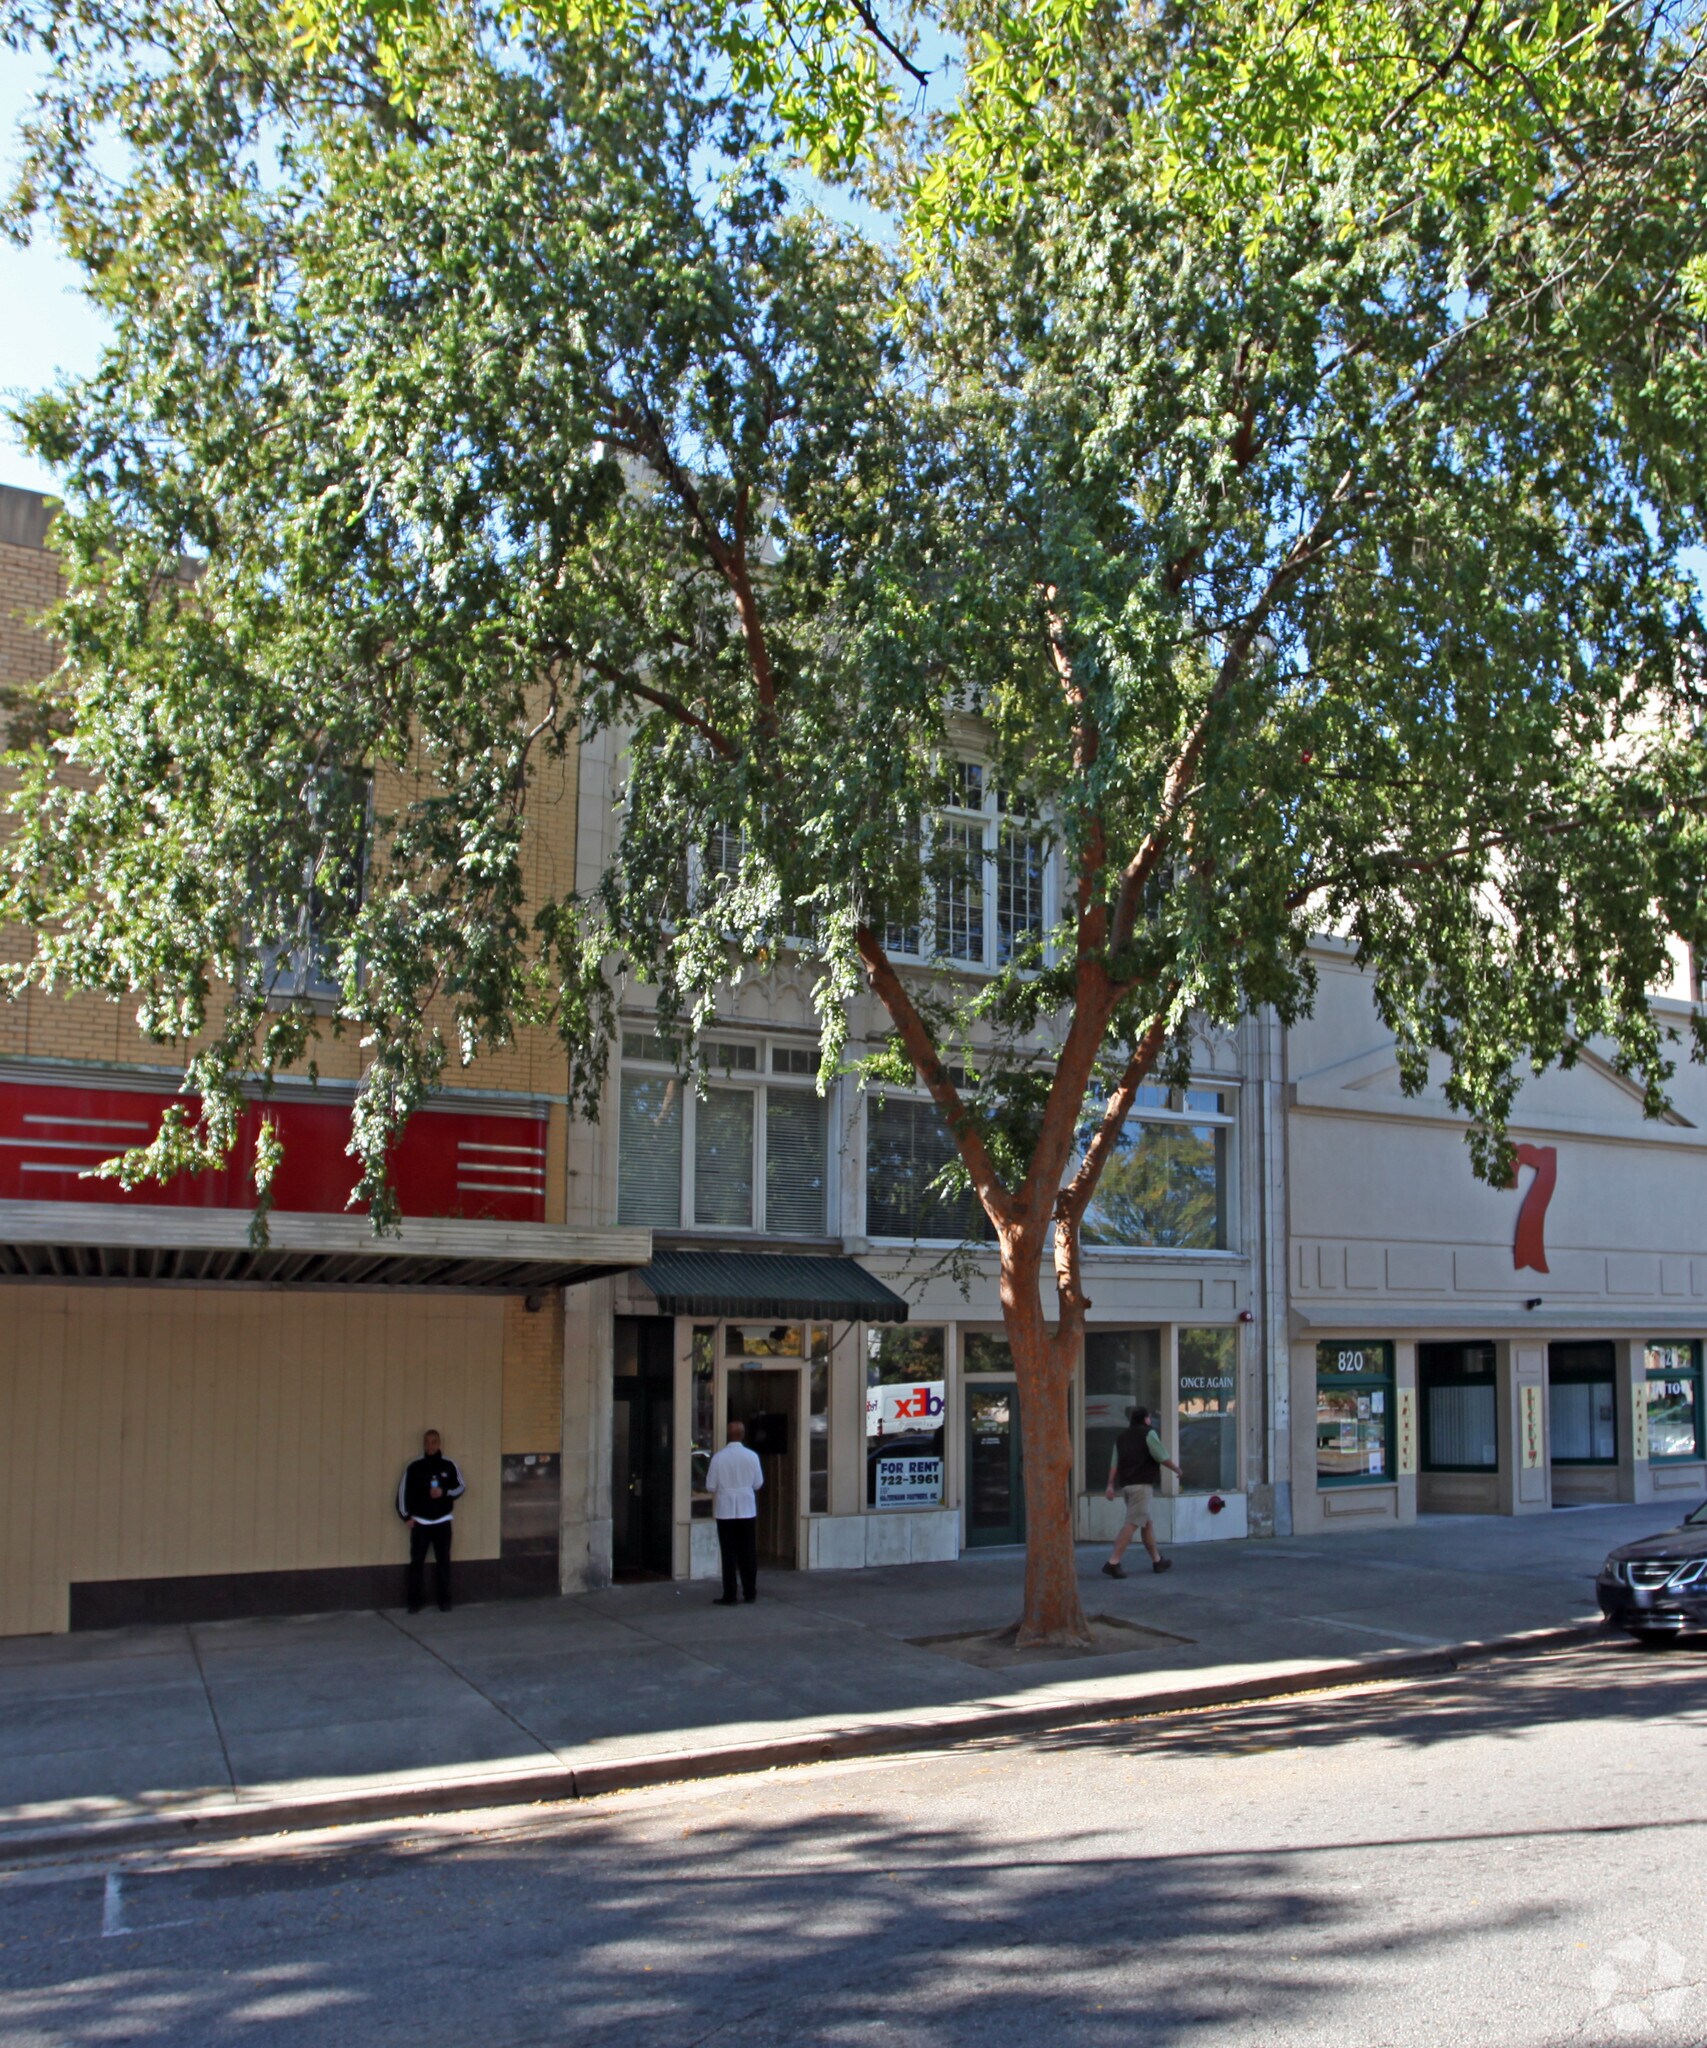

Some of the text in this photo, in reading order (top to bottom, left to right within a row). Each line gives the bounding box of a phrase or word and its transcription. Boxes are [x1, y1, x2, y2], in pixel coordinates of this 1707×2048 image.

[1504, 1142, 1557, 1273] 7
[1338, 1351, 1363, 1371] 820
[1181, 1377, 1233, 1388] ONCE AGAIN
[881, 1462, 939, 1473] FOR RENT
[881, 1474, 939, 1485] 722-3961
